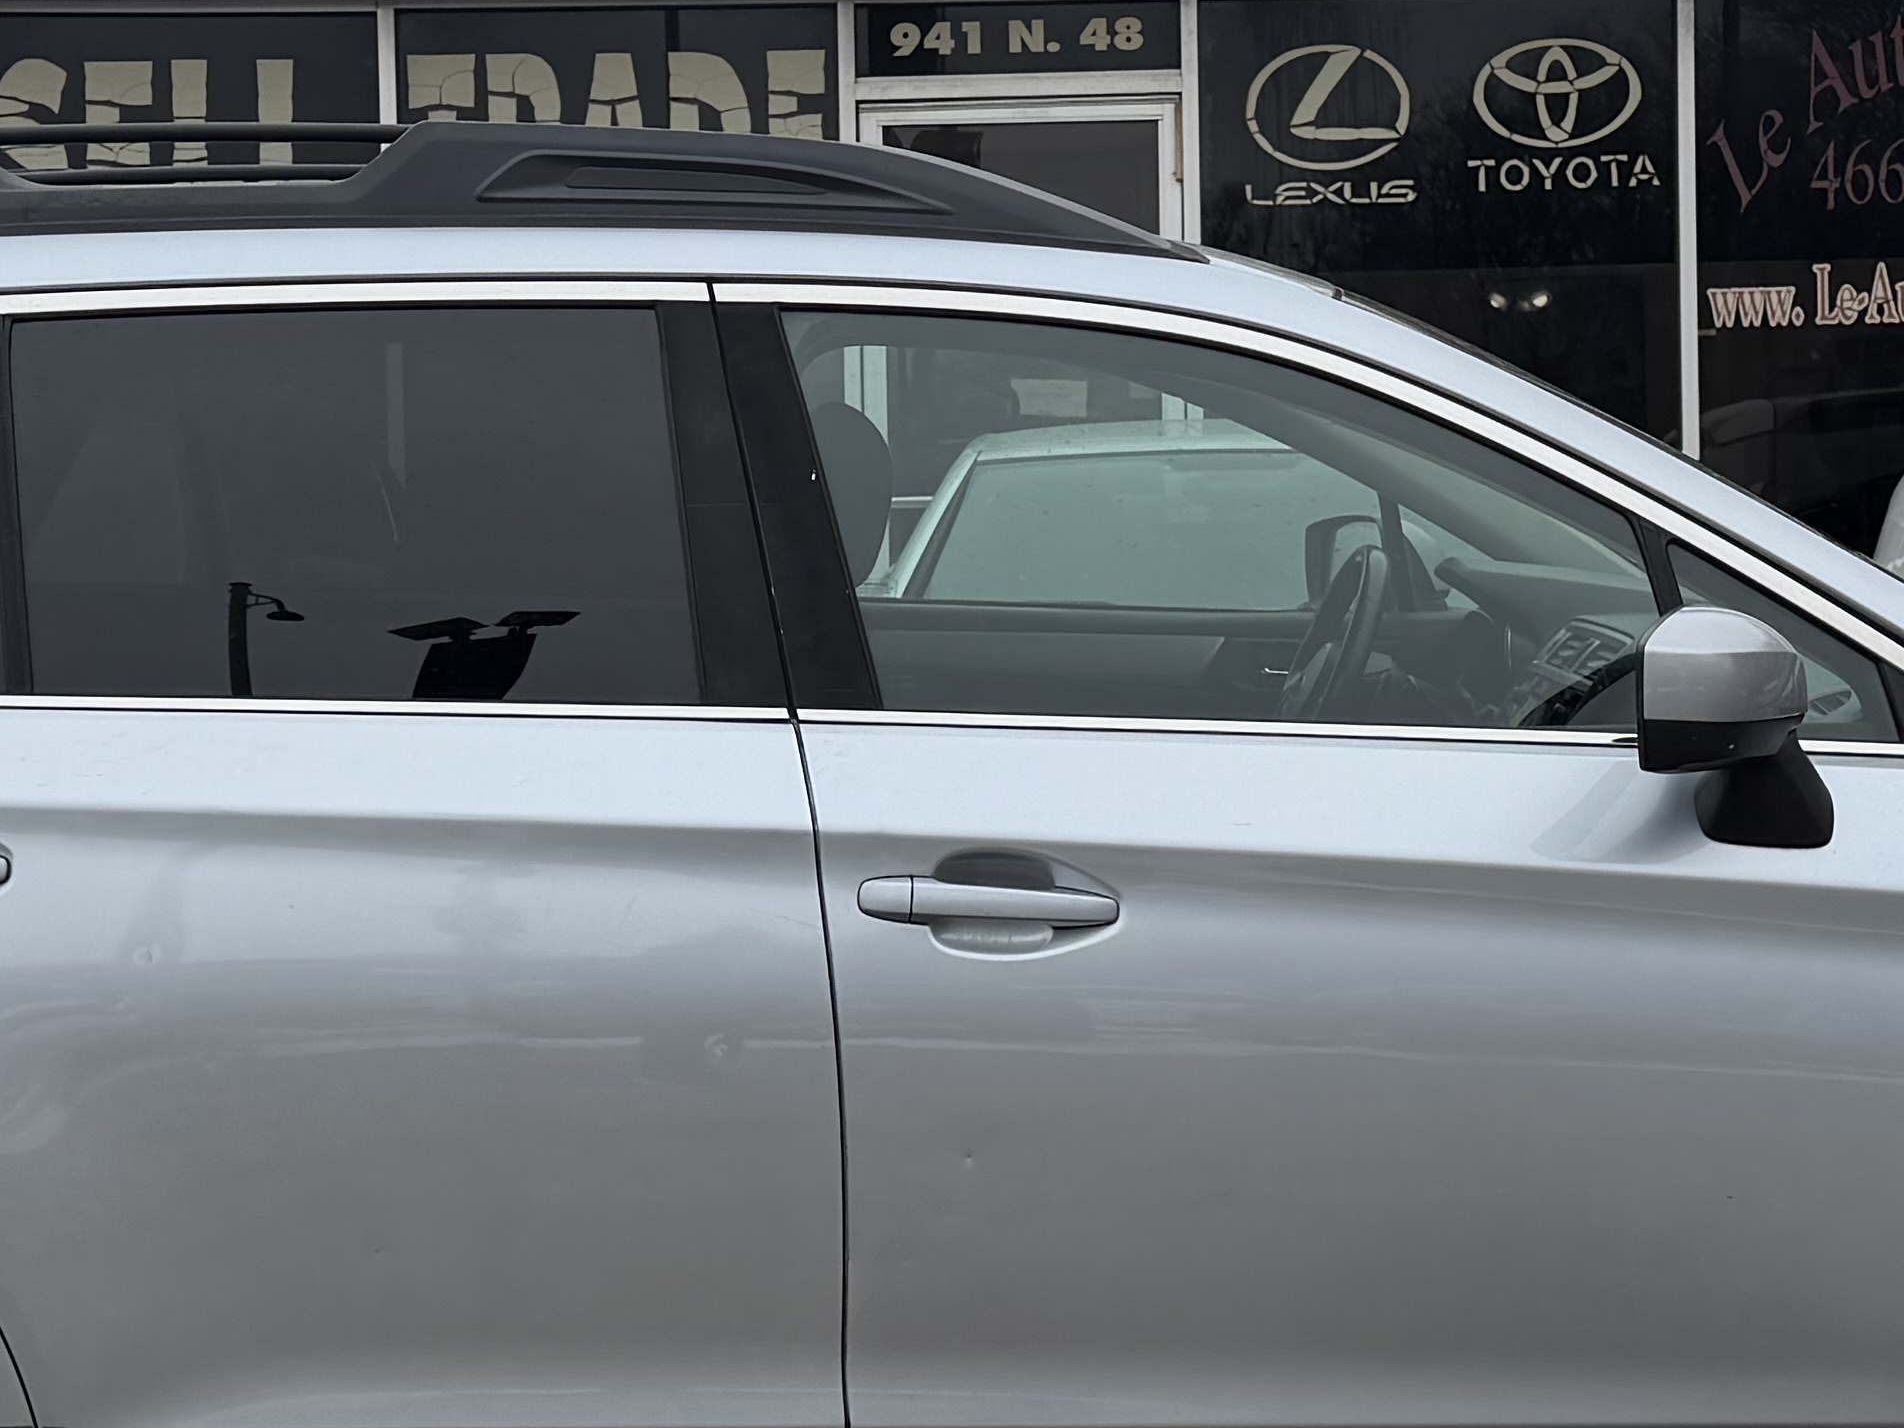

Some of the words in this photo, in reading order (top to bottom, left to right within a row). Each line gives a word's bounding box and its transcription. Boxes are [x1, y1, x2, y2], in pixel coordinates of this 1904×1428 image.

[890, 21, 982, 57] 941
[1008, 19, 1061, 53] N.
[1079, 16, 1144, 51] 48
[1467, 154, 1661, 192] TOYOTA
[1706, 108, 1792, 214] Le
[1245, 179, 1417, 205] LEXUS
[1707, 285, 1805, 328] www.
